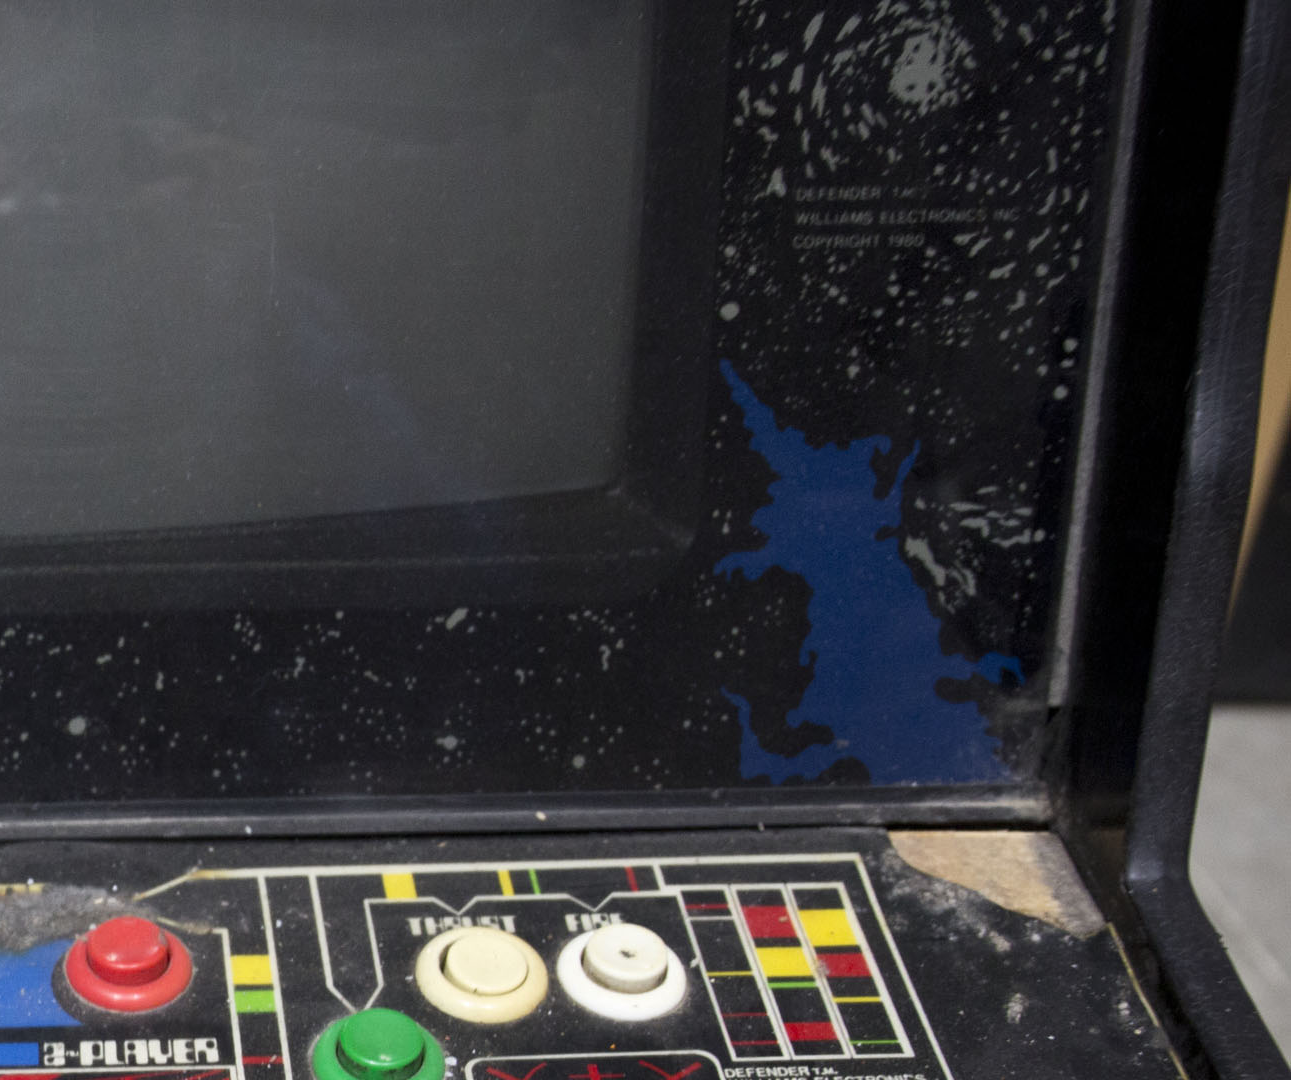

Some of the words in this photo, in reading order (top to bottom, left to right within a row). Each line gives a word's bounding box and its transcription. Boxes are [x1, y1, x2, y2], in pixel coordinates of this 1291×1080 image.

[795, 185, 882, 201] DEFENDER
[796, 209, 874, 226] WILLIAMS
[879, 208, 987, 225] ELECTRONICS
[792, 233, 881, 250] COPYRIGHT
[888, 233, 926, 248] 1980
[724, 1065, 811, 1078] DEFENDER
